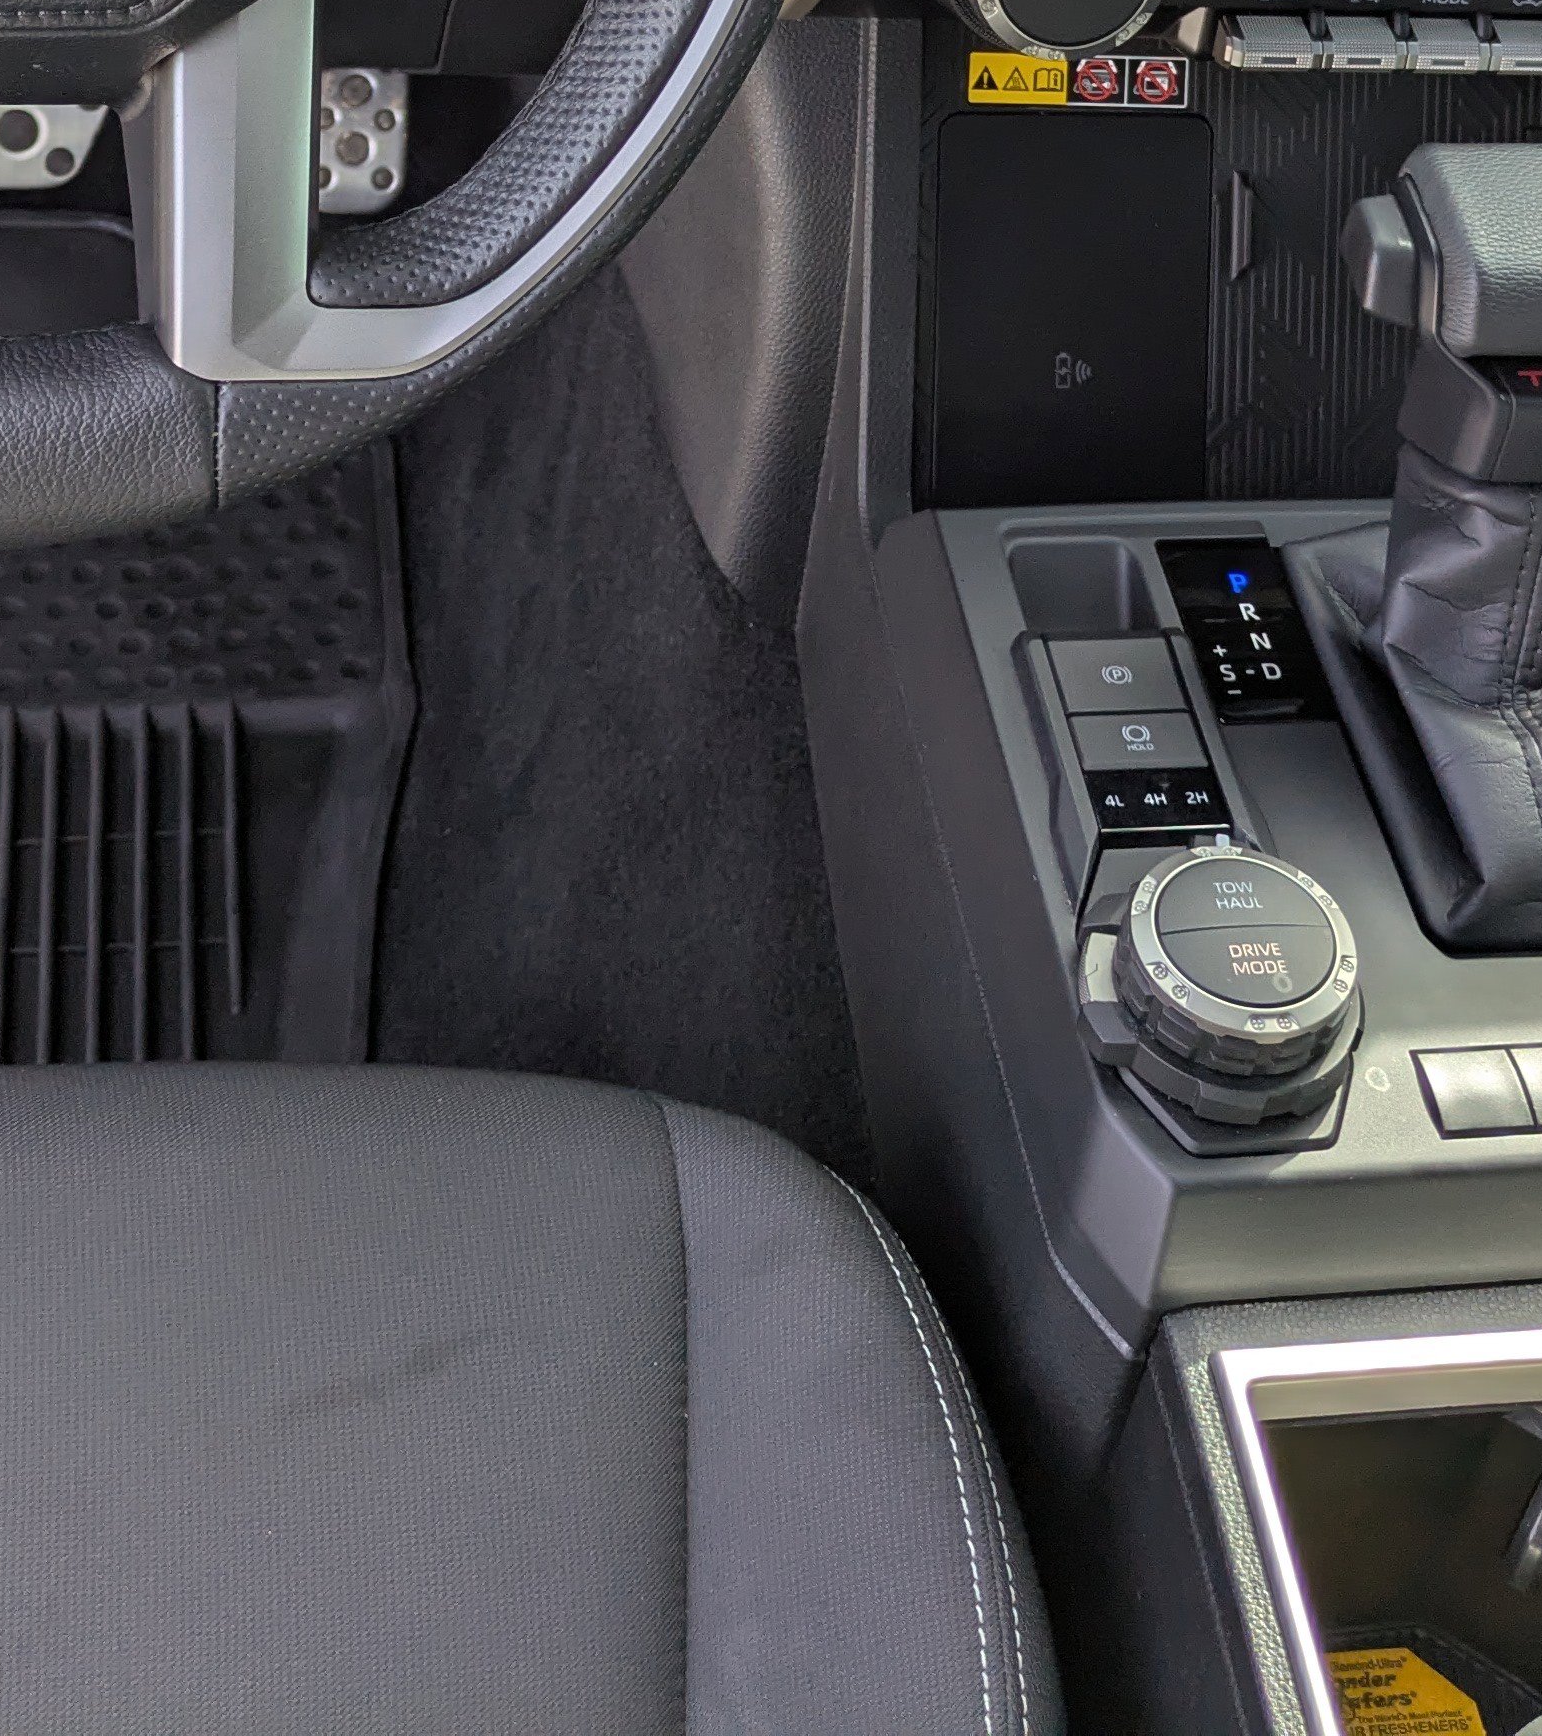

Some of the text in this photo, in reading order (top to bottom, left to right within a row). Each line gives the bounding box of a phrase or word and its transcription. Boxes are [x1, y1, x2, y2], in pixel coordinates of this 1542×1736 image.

[1228, 572, 1249, 593] P
[1238, 602, 1261, 621] R
[1249, 632, 1273, 651] N
[1219, 664, 1237, 682] S
[1261, 663, 1283, 681] D
[1127, 743, 1154, 751] HOLD
[1105, 794, 1125, 807] 4L
[1144, 793, 1168, 806] 4H
[1186, 790, 1209, 805] 2H
[1213, 880, 1254, 894] TOW
[1215, 895, 1264, 910] HAUL
[1229, 942, 1282, 958] DRIVE
[1232, 959, 1289, 975] MODE
